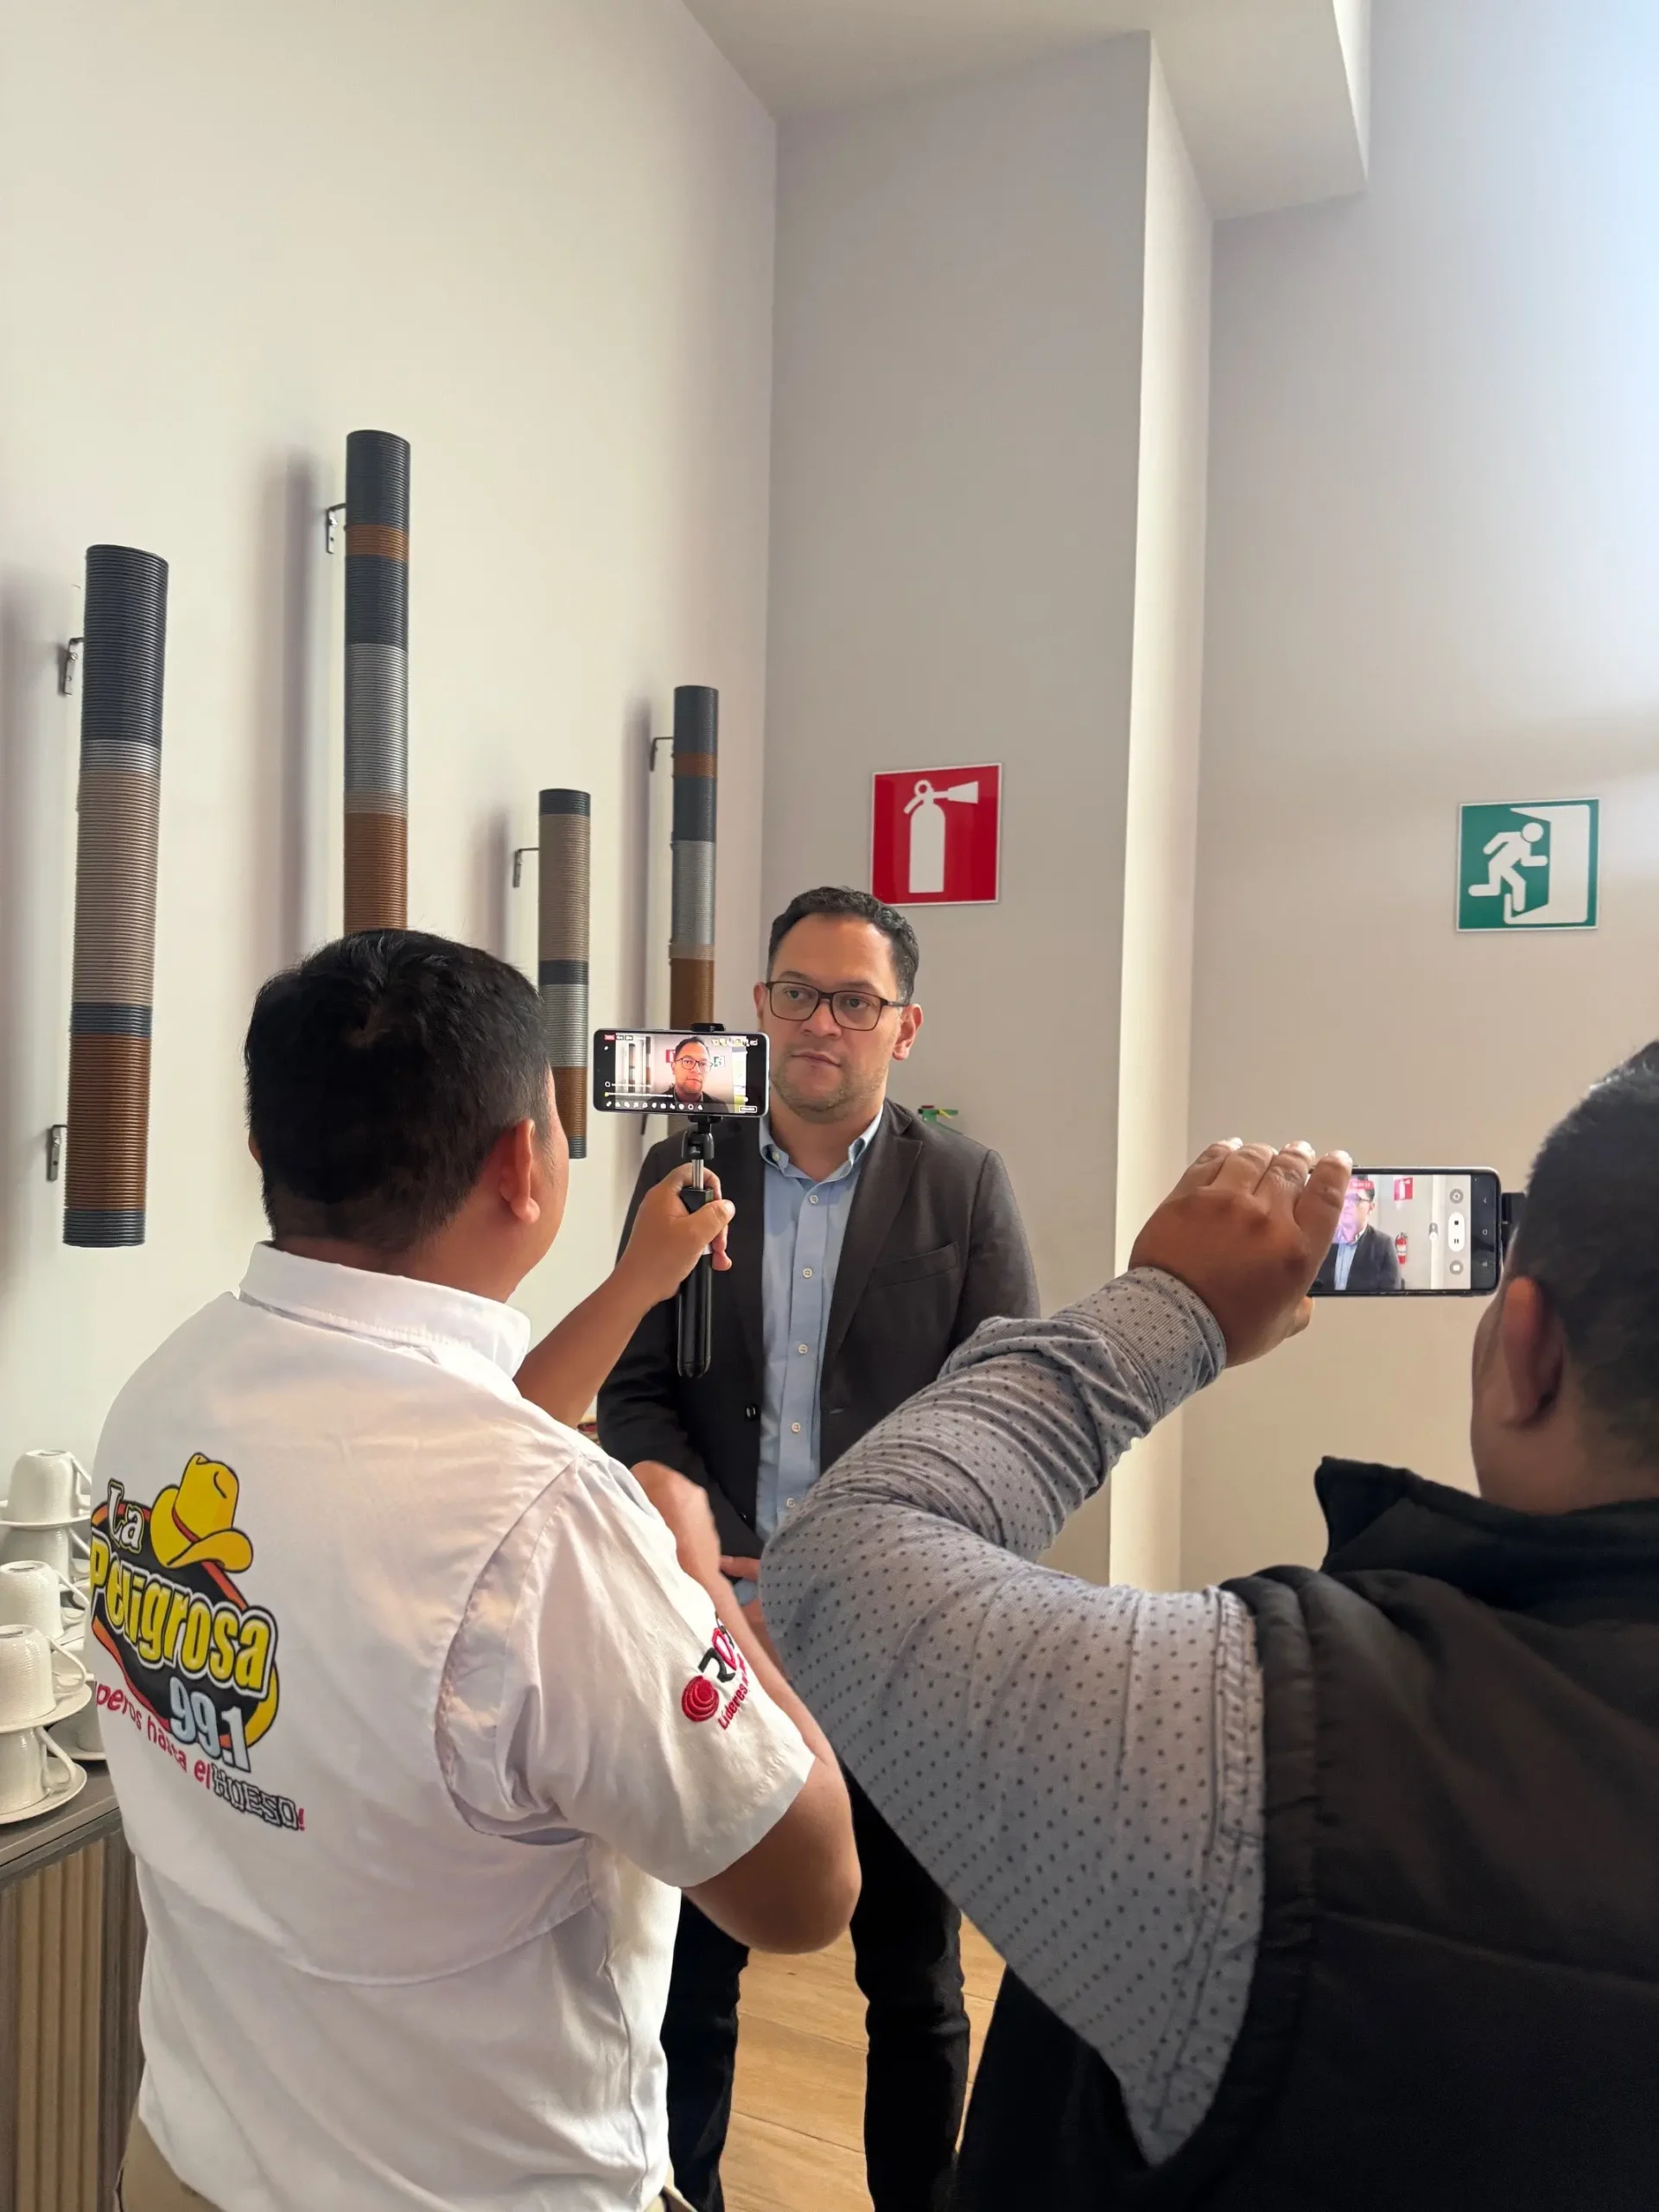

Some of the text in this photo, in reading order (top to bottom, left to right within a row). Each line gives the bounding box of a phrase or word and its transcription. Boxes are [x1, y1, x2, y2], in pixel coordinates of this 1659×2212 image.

[107, 1478, 144, 1554] La
[90, 1531, 273, 1696] Peligrosa
[95, 1681, 143, 1732] peros
[194, 1759, 211, 1790] el
[169, 1676, 251, 1773] 99.1
